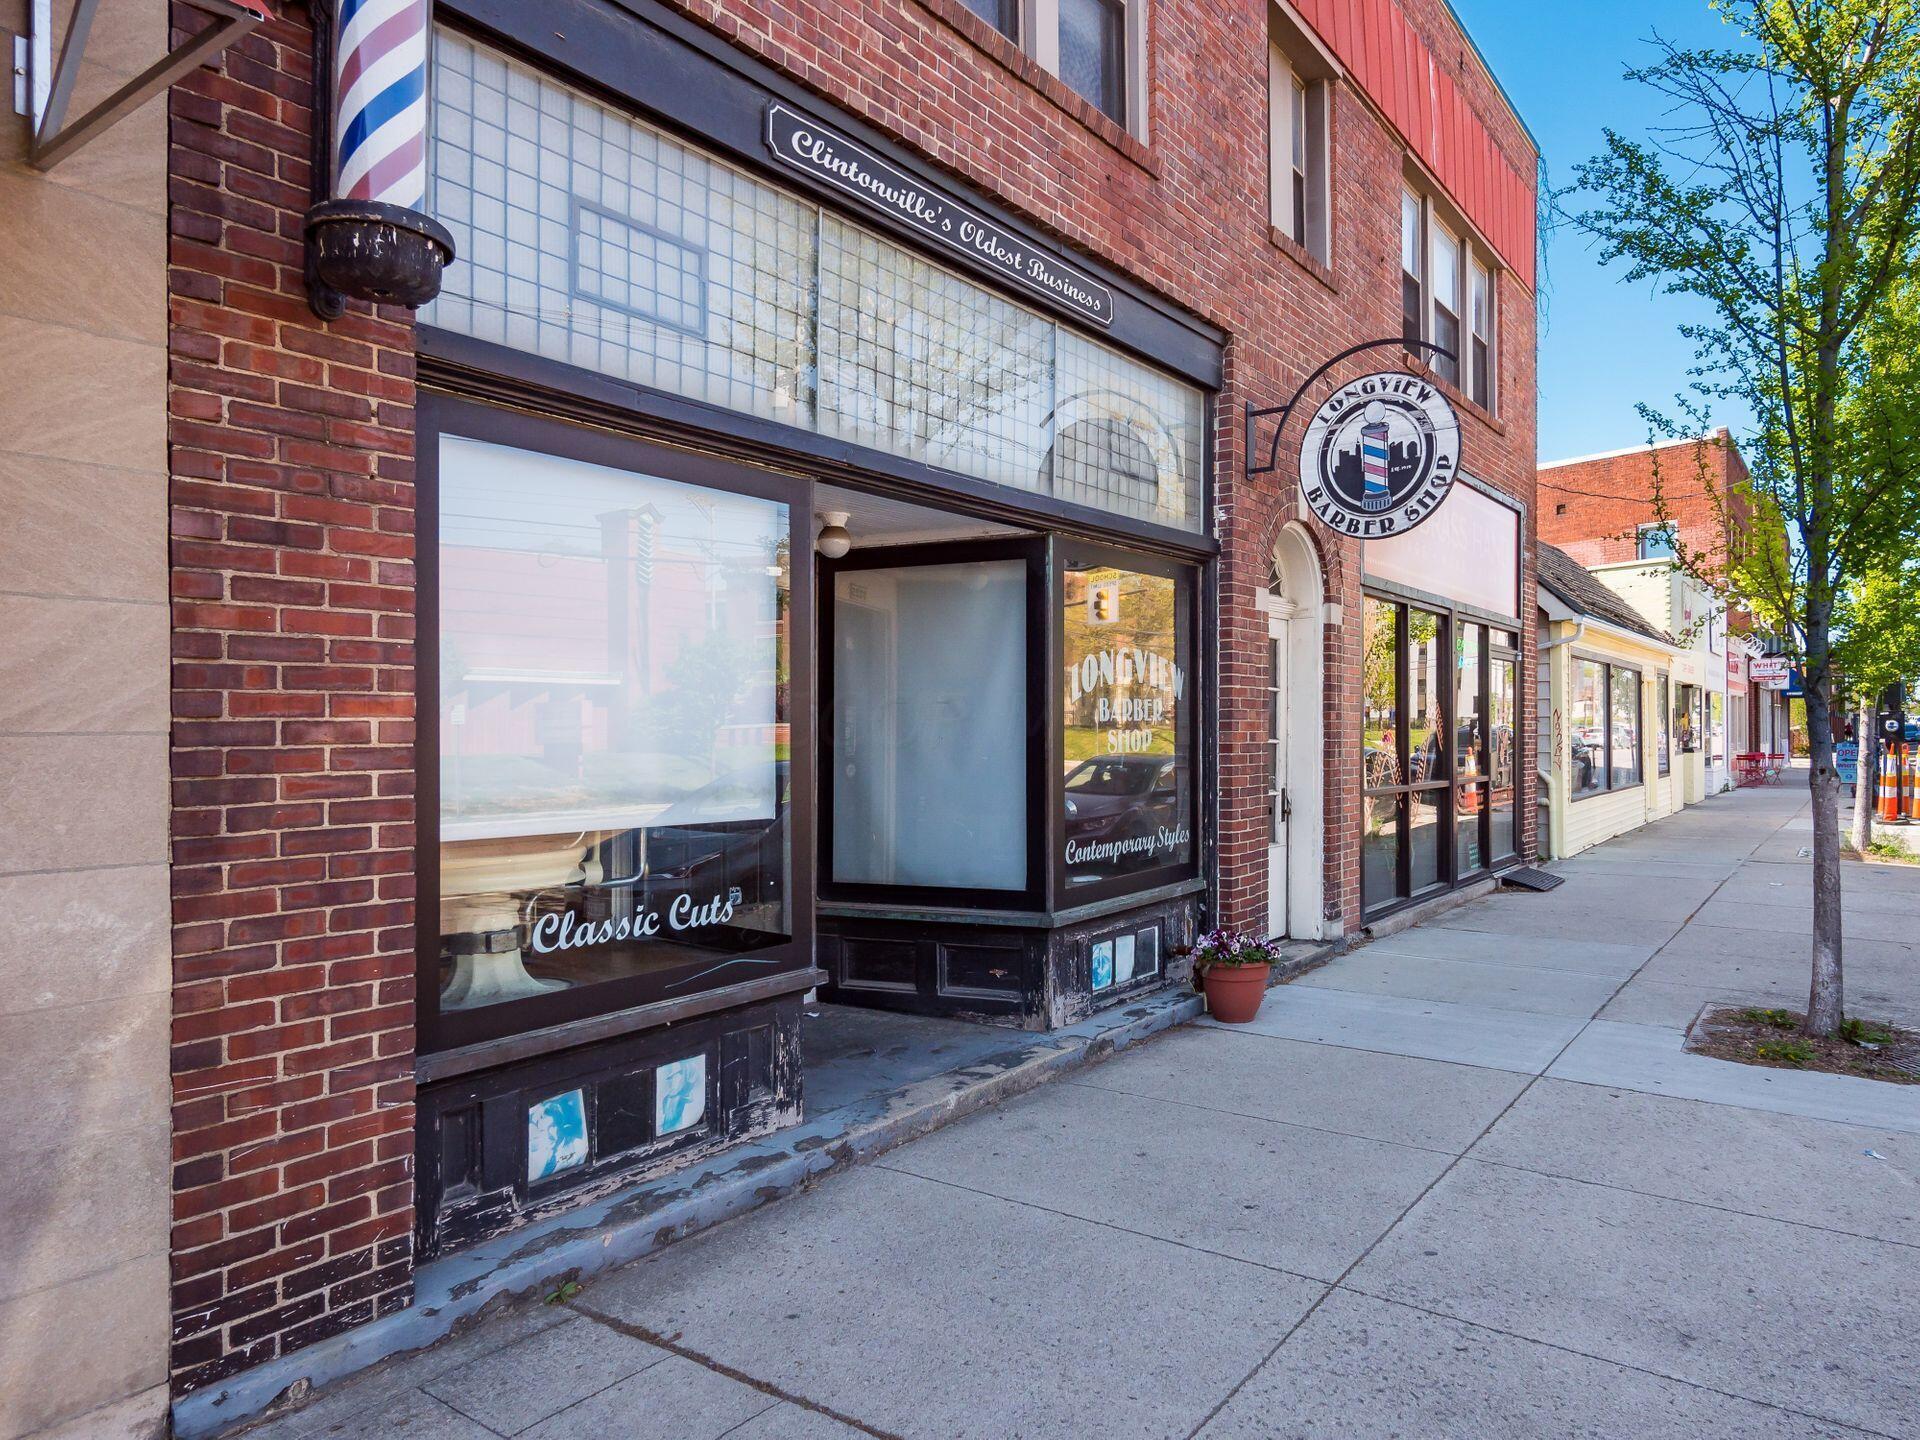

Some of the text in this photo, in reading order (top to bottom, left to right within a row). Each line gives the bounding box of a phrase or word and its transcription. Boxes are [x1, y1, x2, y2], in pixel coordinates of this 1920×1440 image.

[791, 130, 1101, 312] Clintonville's Oldest Business
[1317, 376, 1434, 424] LONGVIEW
[1306, 454, 1452, 535] BARBER SHOP
[1071, 648, 1185, 704] LONGVIEW
[1099, 697, 1163, 722] BARBER
[1107, 728, 1152, 754] SHOP
[1065, 823, 1190, 865] Contemporary Styles
[532, 905, 660, 954] Classic
[669, 893, 734, 931] Cuts
